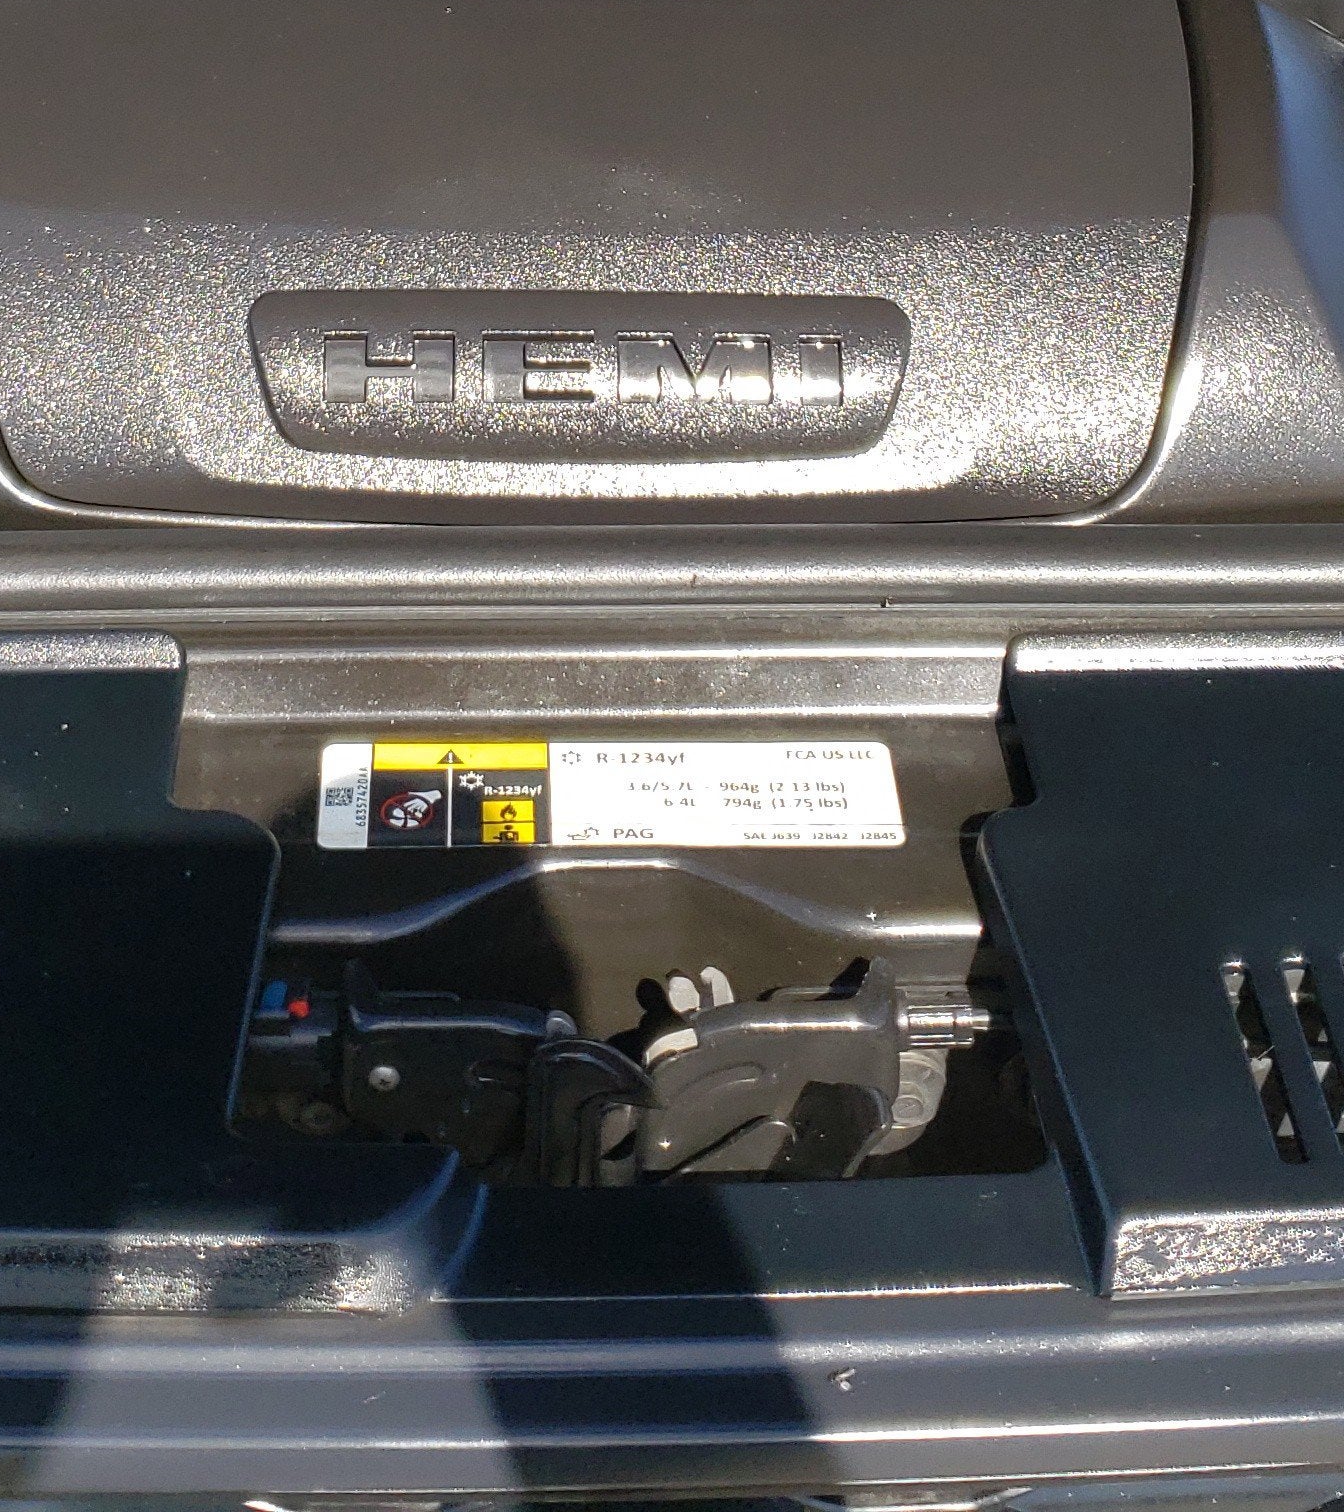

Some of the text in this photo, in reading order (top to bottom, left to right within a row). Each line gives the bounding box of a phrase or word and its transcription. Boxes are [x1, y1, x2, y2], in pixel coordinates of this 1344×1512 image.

[323, 329, 844, 406] HEMI
[596, 751, 686, 766] R-1234yf
[786, 749, 817, 760] FCA
[822, 749, 844, 760] US
[484, 784, 543, 798] R-1234yf
[719, 782, 760, 794] 964g
[769, 781, 811, 794] (213
[815, 781, 846, 794] lbs)
[663, 797, 697, 807] 64L
[723, 797, 762, 810] 794g
[818, 797, 849, 810] lbs)
[613, 828, 655, 839] PAG
